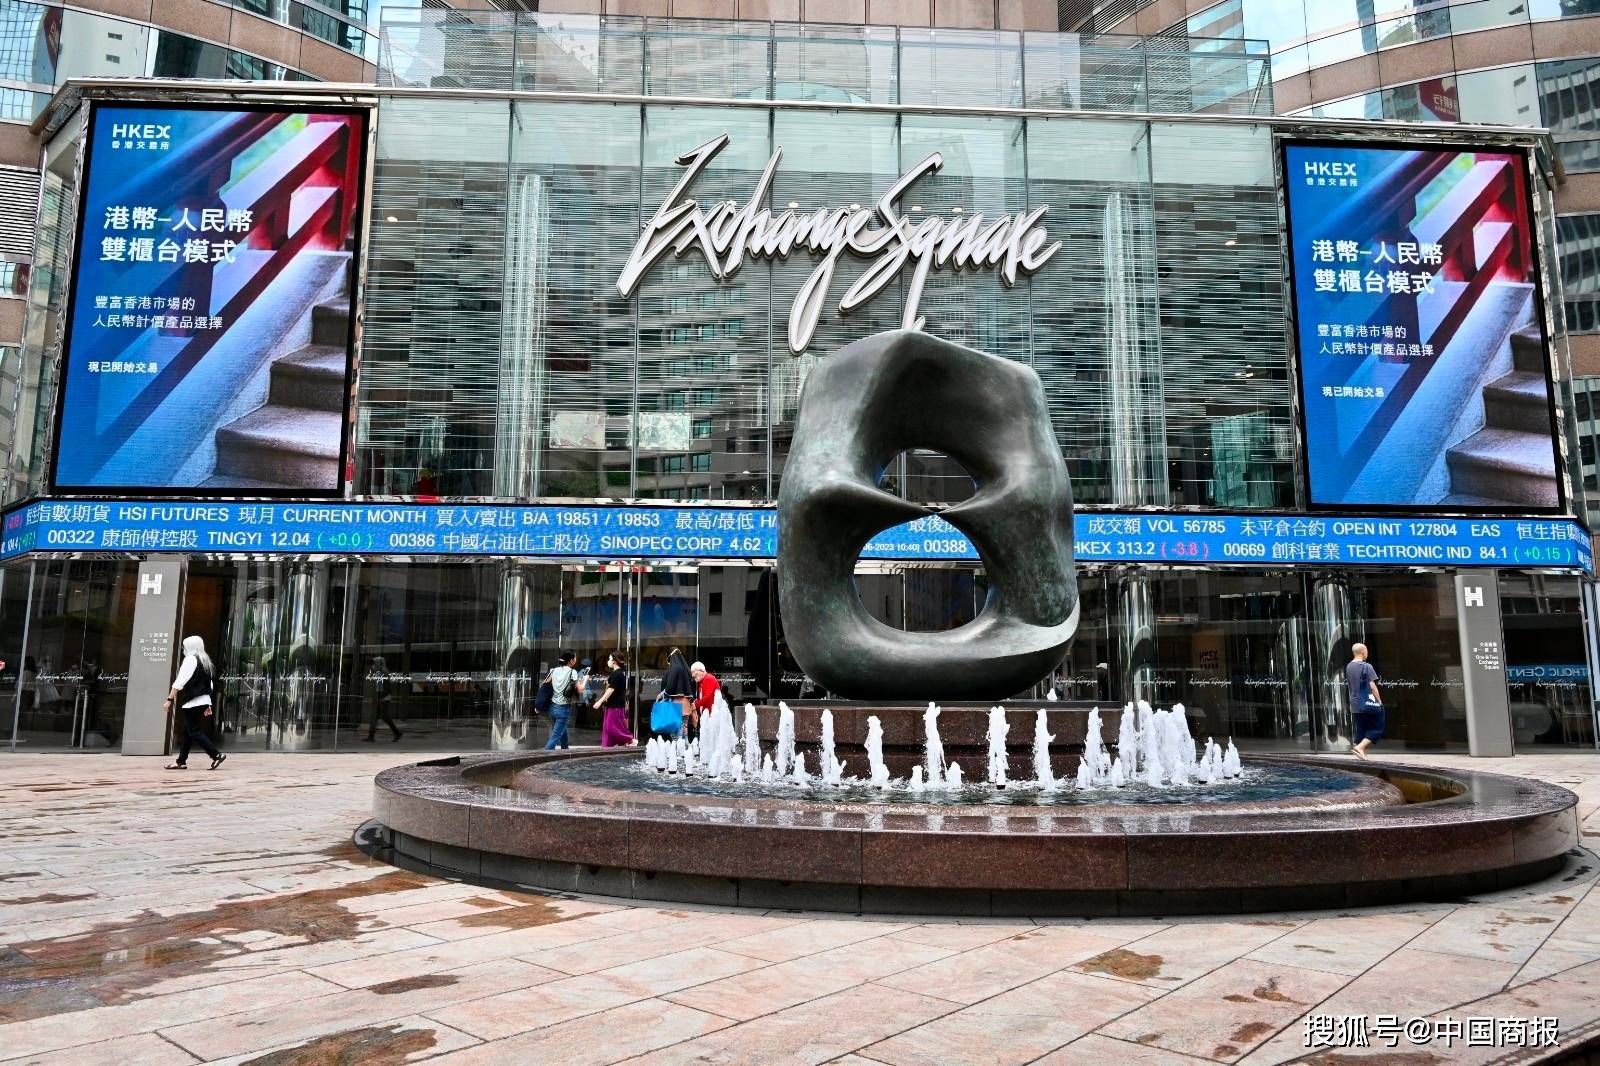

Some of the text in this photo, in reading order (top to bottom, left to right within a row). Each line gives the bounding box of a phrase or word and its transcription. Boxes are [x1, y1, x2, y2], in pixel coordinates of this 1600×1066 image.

[112, 123, 171, 139] HKEX
[111, 141, 169, 150] 香港交易所
[1304, 161, 1357, 176] HKEX
[1306, 177, 1358, 187] 香港交易所
[100, 236, 237, 263] 雙櫃台模式
[616, 133, 1063, 357] Exchange Square
[1313, 268, 1435, 295] 雙櫃台模式
[93, 295, 196, 311] 豐富香港市場的
[91, 314, 223, 330] 人民幣計價產品選擇
[1317, 324, 1407, 339] 豐富香港市場的
[1319, 341, 1434, 357] 人民幣計價產品選擇
[87, 361, 158, 374] 現已開始交易
[1321, 386, 1385, 398] 現已開始交易
[119, 507, 147, 520] HSI
[152, 507, 229, 522] FUTURES
[238, 506, 274, 525] 現月
[283, 509, 363, 523] CURRENT
[367, 509, 426, 523] MONTH
[523, 512, 549, 525] B/A
[556, 512, 599, 526] 19851
[616, 513, 660, 527] 19853
[675, 511, 754, 530] 最高/最低
[1088, 518, 1141, 535] 成交額
[1147, 519, 1178, 533] VOL
[1183, 520, 1226, 533] 56785
[1240, 519, 1325, 537] 未平倉合約
[1333, 522, 1375, 536] OPEN
[1379, 522, 1402, 536] INT
[1409, 523, 1457, 537] 127804
[1471, 524, 1501, 537] EAS
[47, 530, 95, 544] 00322
[100, 529, 199, 548] 康師傅控股
[207, 531, 262, 545] TINGYI
[271, 532, 310, 546] 12.04
[389, 533, 435, 547] 00386
[443, 532, 592, 552] 中國石油化工股份
[601, 536, 672, 550] SINOPEC
[676, 536, 722, 550] CORP
[730, 537, 761, 551] 4.62
[923, 539, 967, 553] 00388
[1117, 541, 1155, 555] 313.2
[1223, 543, 1265, 556] 00669
[1272, 542, 1340, 560] 創科實業
[1346, 544, 1443, 559] TECHTRONIC
[1446, 546, 1472, 559] IND
[1479, 546, 1507, 559] 84.1
